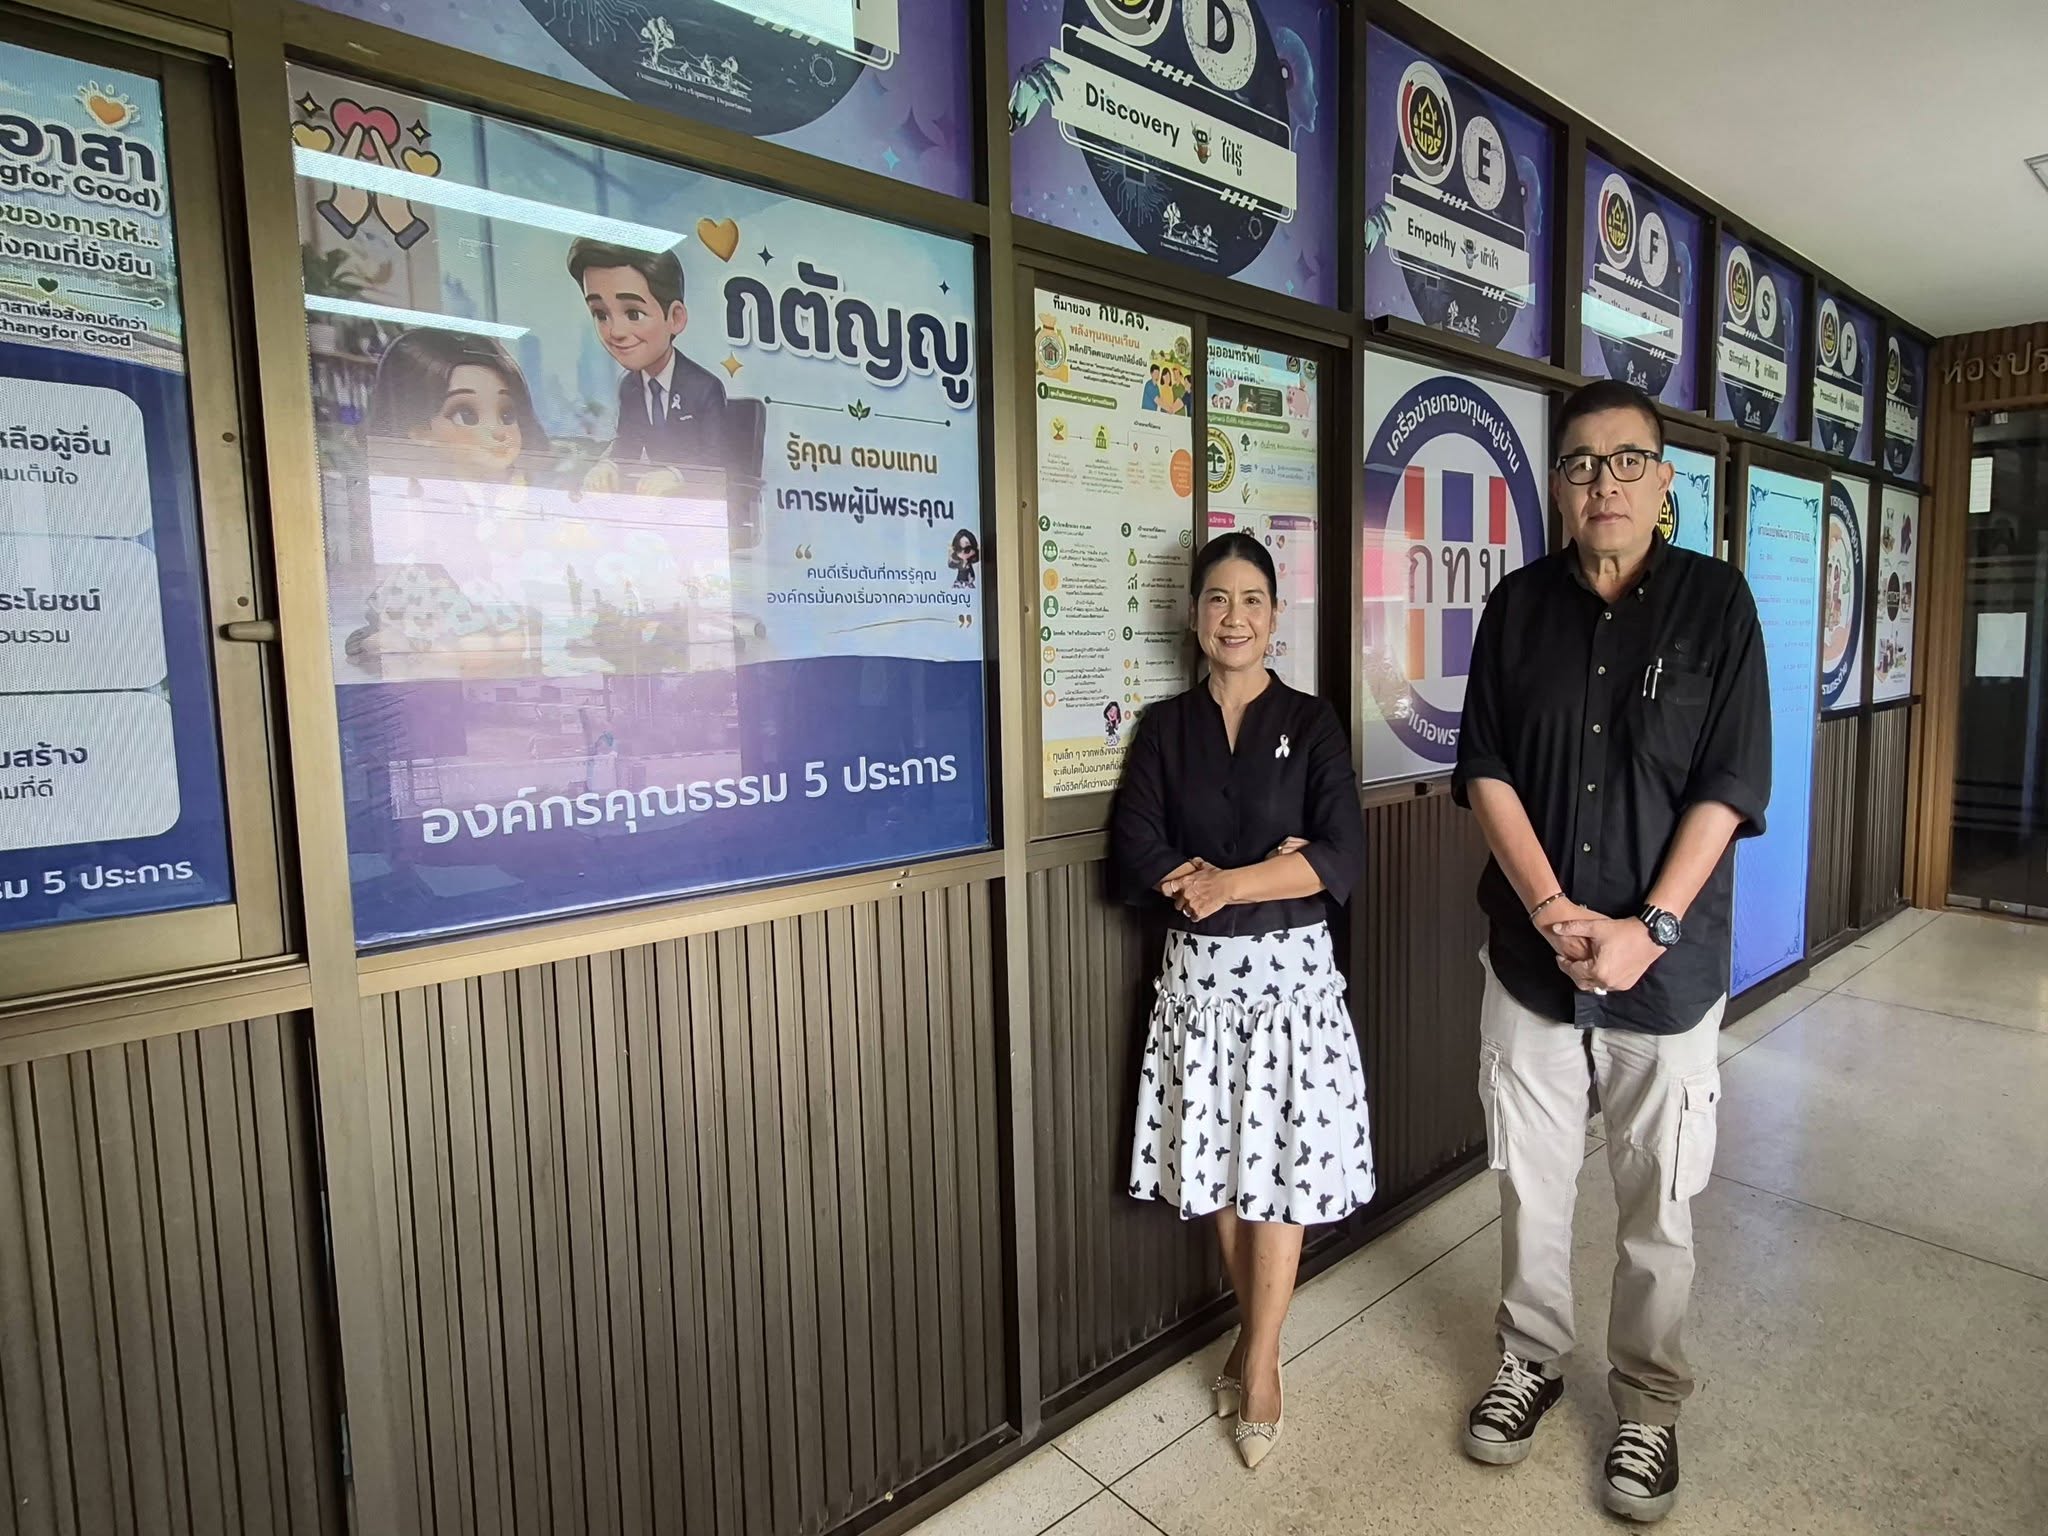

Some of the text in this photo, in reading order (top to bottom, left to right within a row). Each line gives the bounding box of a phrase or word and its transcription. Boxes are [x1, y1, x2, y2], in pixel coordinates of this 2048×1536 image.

[1085, 82, 1180, 148] Discovery
[1478, 137, 1491, 185] E
[73, 176, 161, 212] Good)
[0, 204, 159, 247] ของการให้...
[1407, 217, 1457, 256] Empathy
[1649, 229, 1659, 265] F
[1761, 291, 1771, 321] S
[0, 318, 131, 347] hangfor Good
[723, 261, 969, 404] กตัญญู
[786, 432, 938, 474] รู้คุณ ตอบแทน
[1386, 393, 1521, 474] เครือข่ายกองทุนหมู่บ้าน
[776, 485, 954, 527] เคารพผู้มีพระคุณ
[807, 561, 937, 585] คนดีเริ่มต้นที่การรู้คุณ
[767, 586, 971, 608] องค์กรมั่นคงเริ่มจากความกตัญญู
[422, 754, 957, 844] องค์กรคุณธรรม 5 ประการ
[44, 870, 67, 894] 5
[80, 860, 194, 890] ประการ
